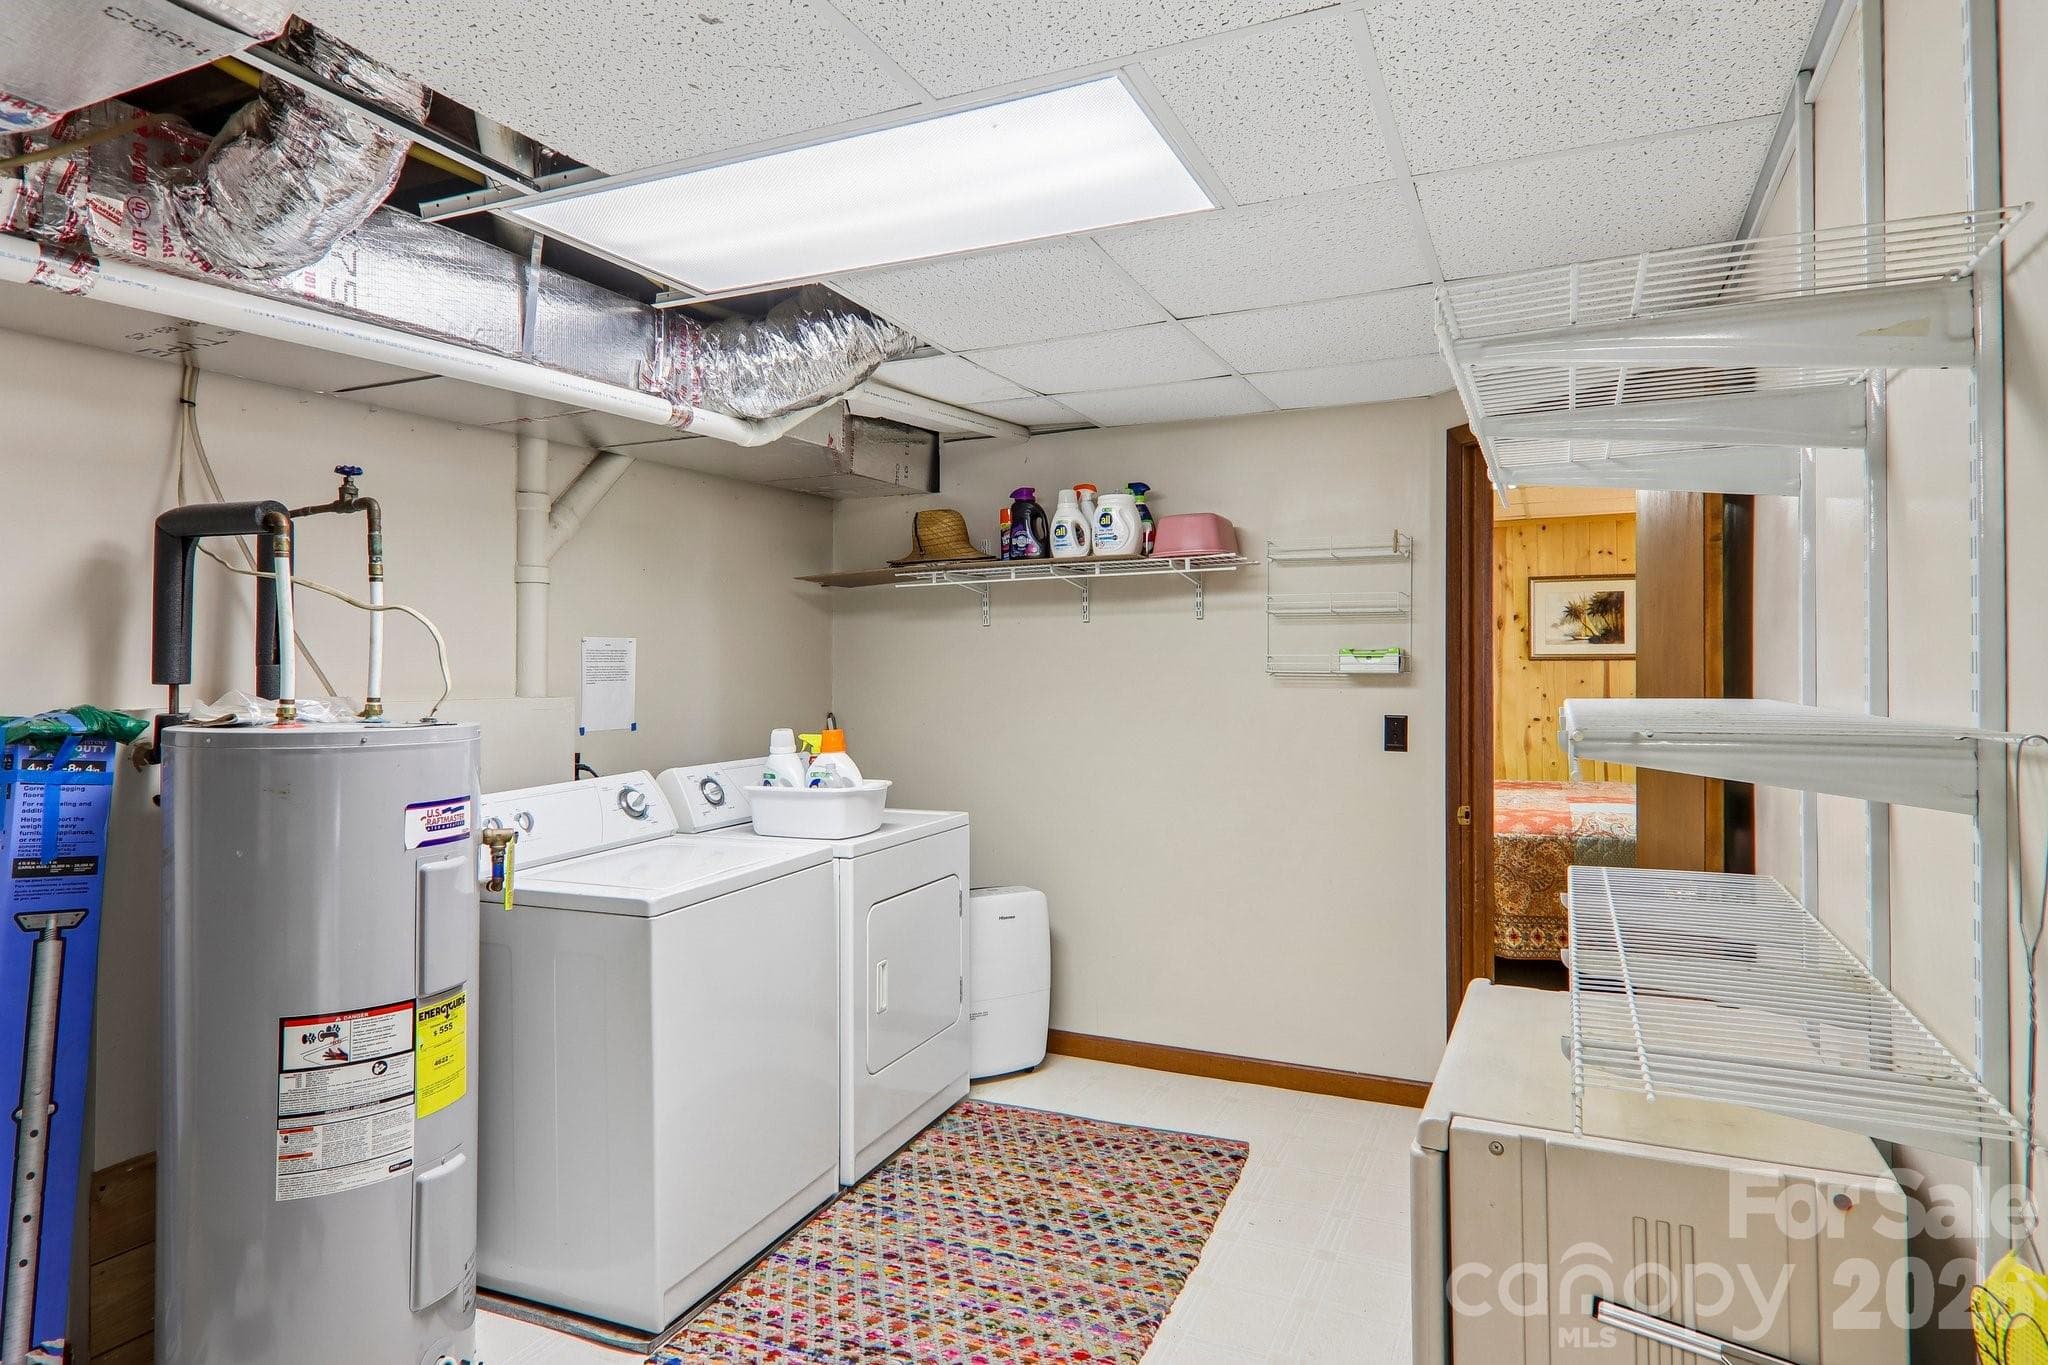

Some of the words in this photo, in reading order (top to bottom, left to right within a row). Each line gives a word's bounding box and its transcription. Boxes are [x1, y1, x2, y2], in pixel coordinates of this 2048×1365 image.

[1101, 515, 1111, 525] all
[1055, 526, 1066, 537] all
[426, 808, 442, 819] U.S.
[439, 1022, 453, 1034] 555
